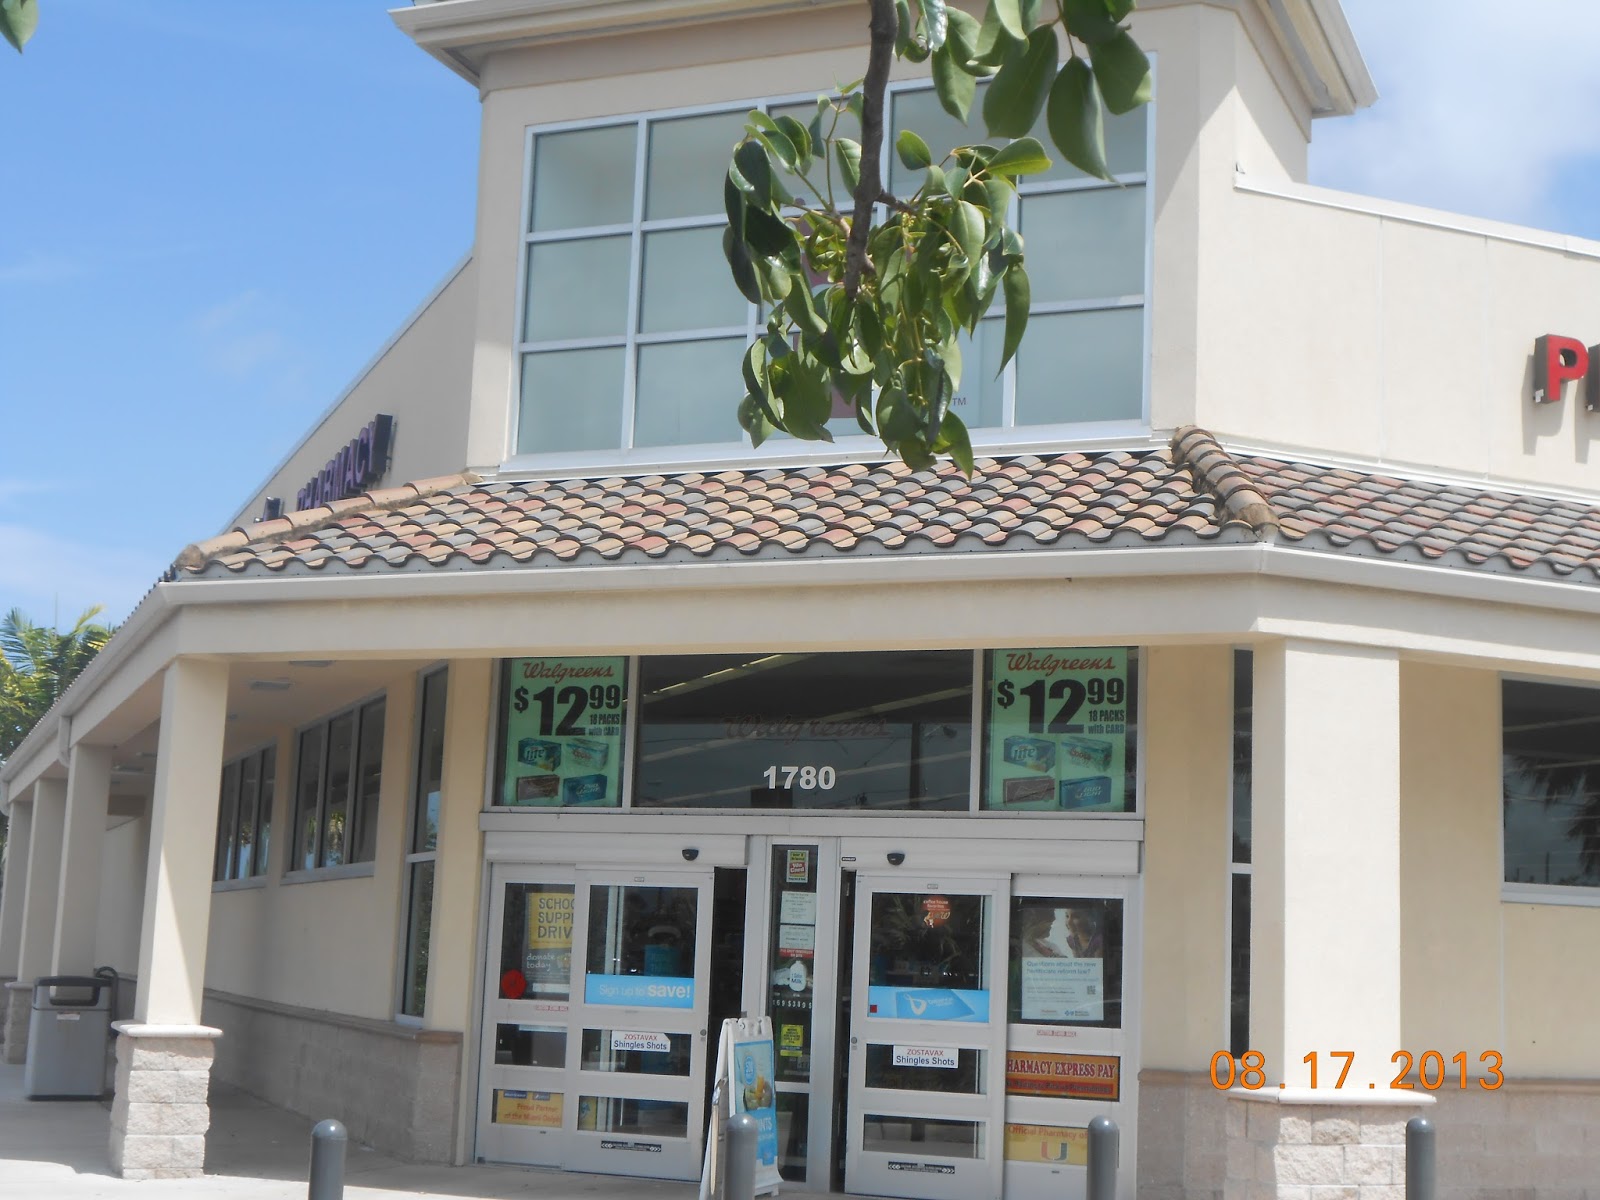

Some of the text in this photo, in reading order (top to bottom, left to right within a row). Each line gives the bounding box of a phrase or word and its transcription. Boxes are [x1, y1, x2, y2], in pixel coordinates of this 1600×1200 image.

[1534, 333, 1600, 413] P
[1006, 653, 1116, 677] Walgreens
[522, 661, 615, 684] Walgreens
[589, 713, 620, 725] 18 PACKS
[1088, 709, 1125, 722] 18 PACKS
[721, 712, 889, 746] Walgreens
[1088, 723, 1125, 735] with CARD
[763, 765, 836, 790] 1780
[526, 960, 551, 971] today
[599, 983, 619, 998] Sign
[647, 984, 691, 999] save!
[624, 1033, 658, 1041] ZOSTAVAX
[613, 1040, 667, 1050] Shingles Shots
[906, 1048, 944, 1056] ZOSTAVAX
[896, 1055, 955, 1066] Shingles Shots
[1054, 1061, 1096, 1078] EXPRESS
[1097, 1064, 1116, 1079] PAY
[1008, 1124, 1037, 1135] Official
[1038, 1126, 1077, 1141] Pharmacy
